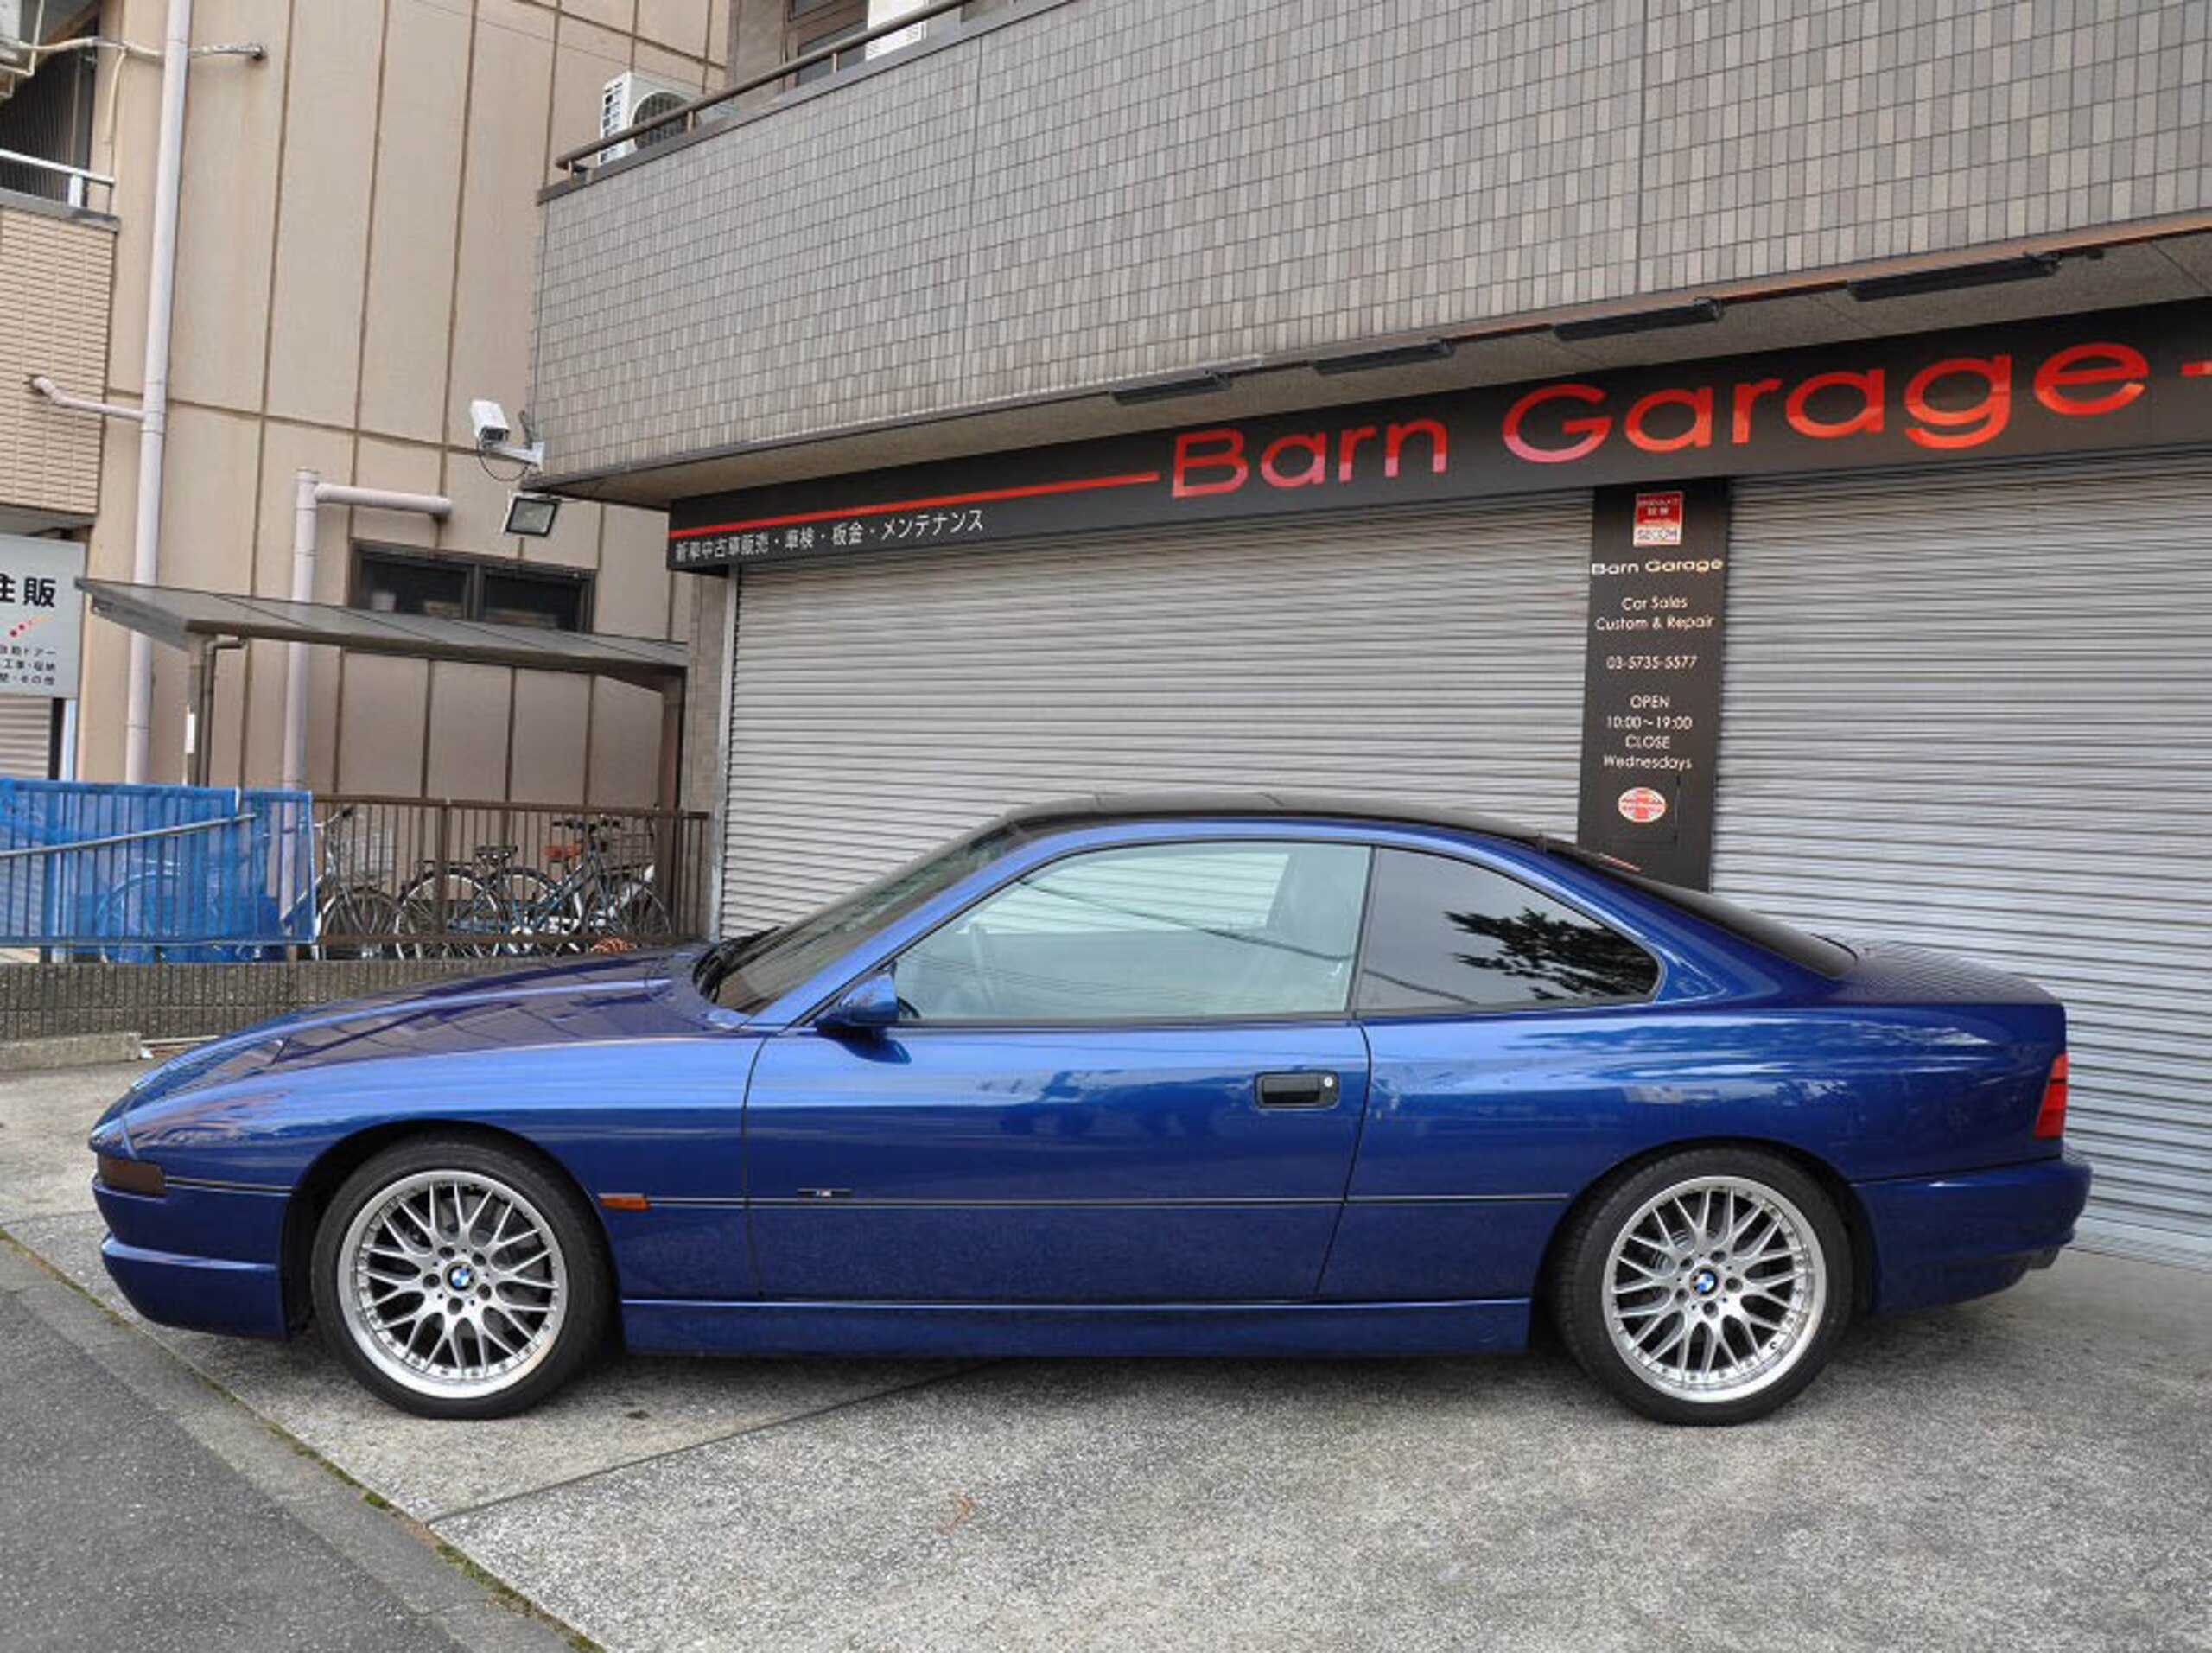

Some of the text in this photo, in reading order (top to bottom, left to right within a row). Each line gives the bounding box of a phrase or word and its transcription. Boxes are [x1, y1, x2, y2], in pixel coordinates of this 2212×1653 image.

[1172, 344, 2148, 498] Barn Garage
[1592, 559, 1724, 575] Barn Garage
[1621, 595, 1688, 611] Car Sales
[1595, 614, 1714, 631] Custom & Repair
[1606, 655, 1698, 670] 03-5735-5577
[1630, 695, 1670, 709] OPEN
[1625, 734, 1671, 749] CLOSE
[1603, 755, 1693, 771] Wednesdays
